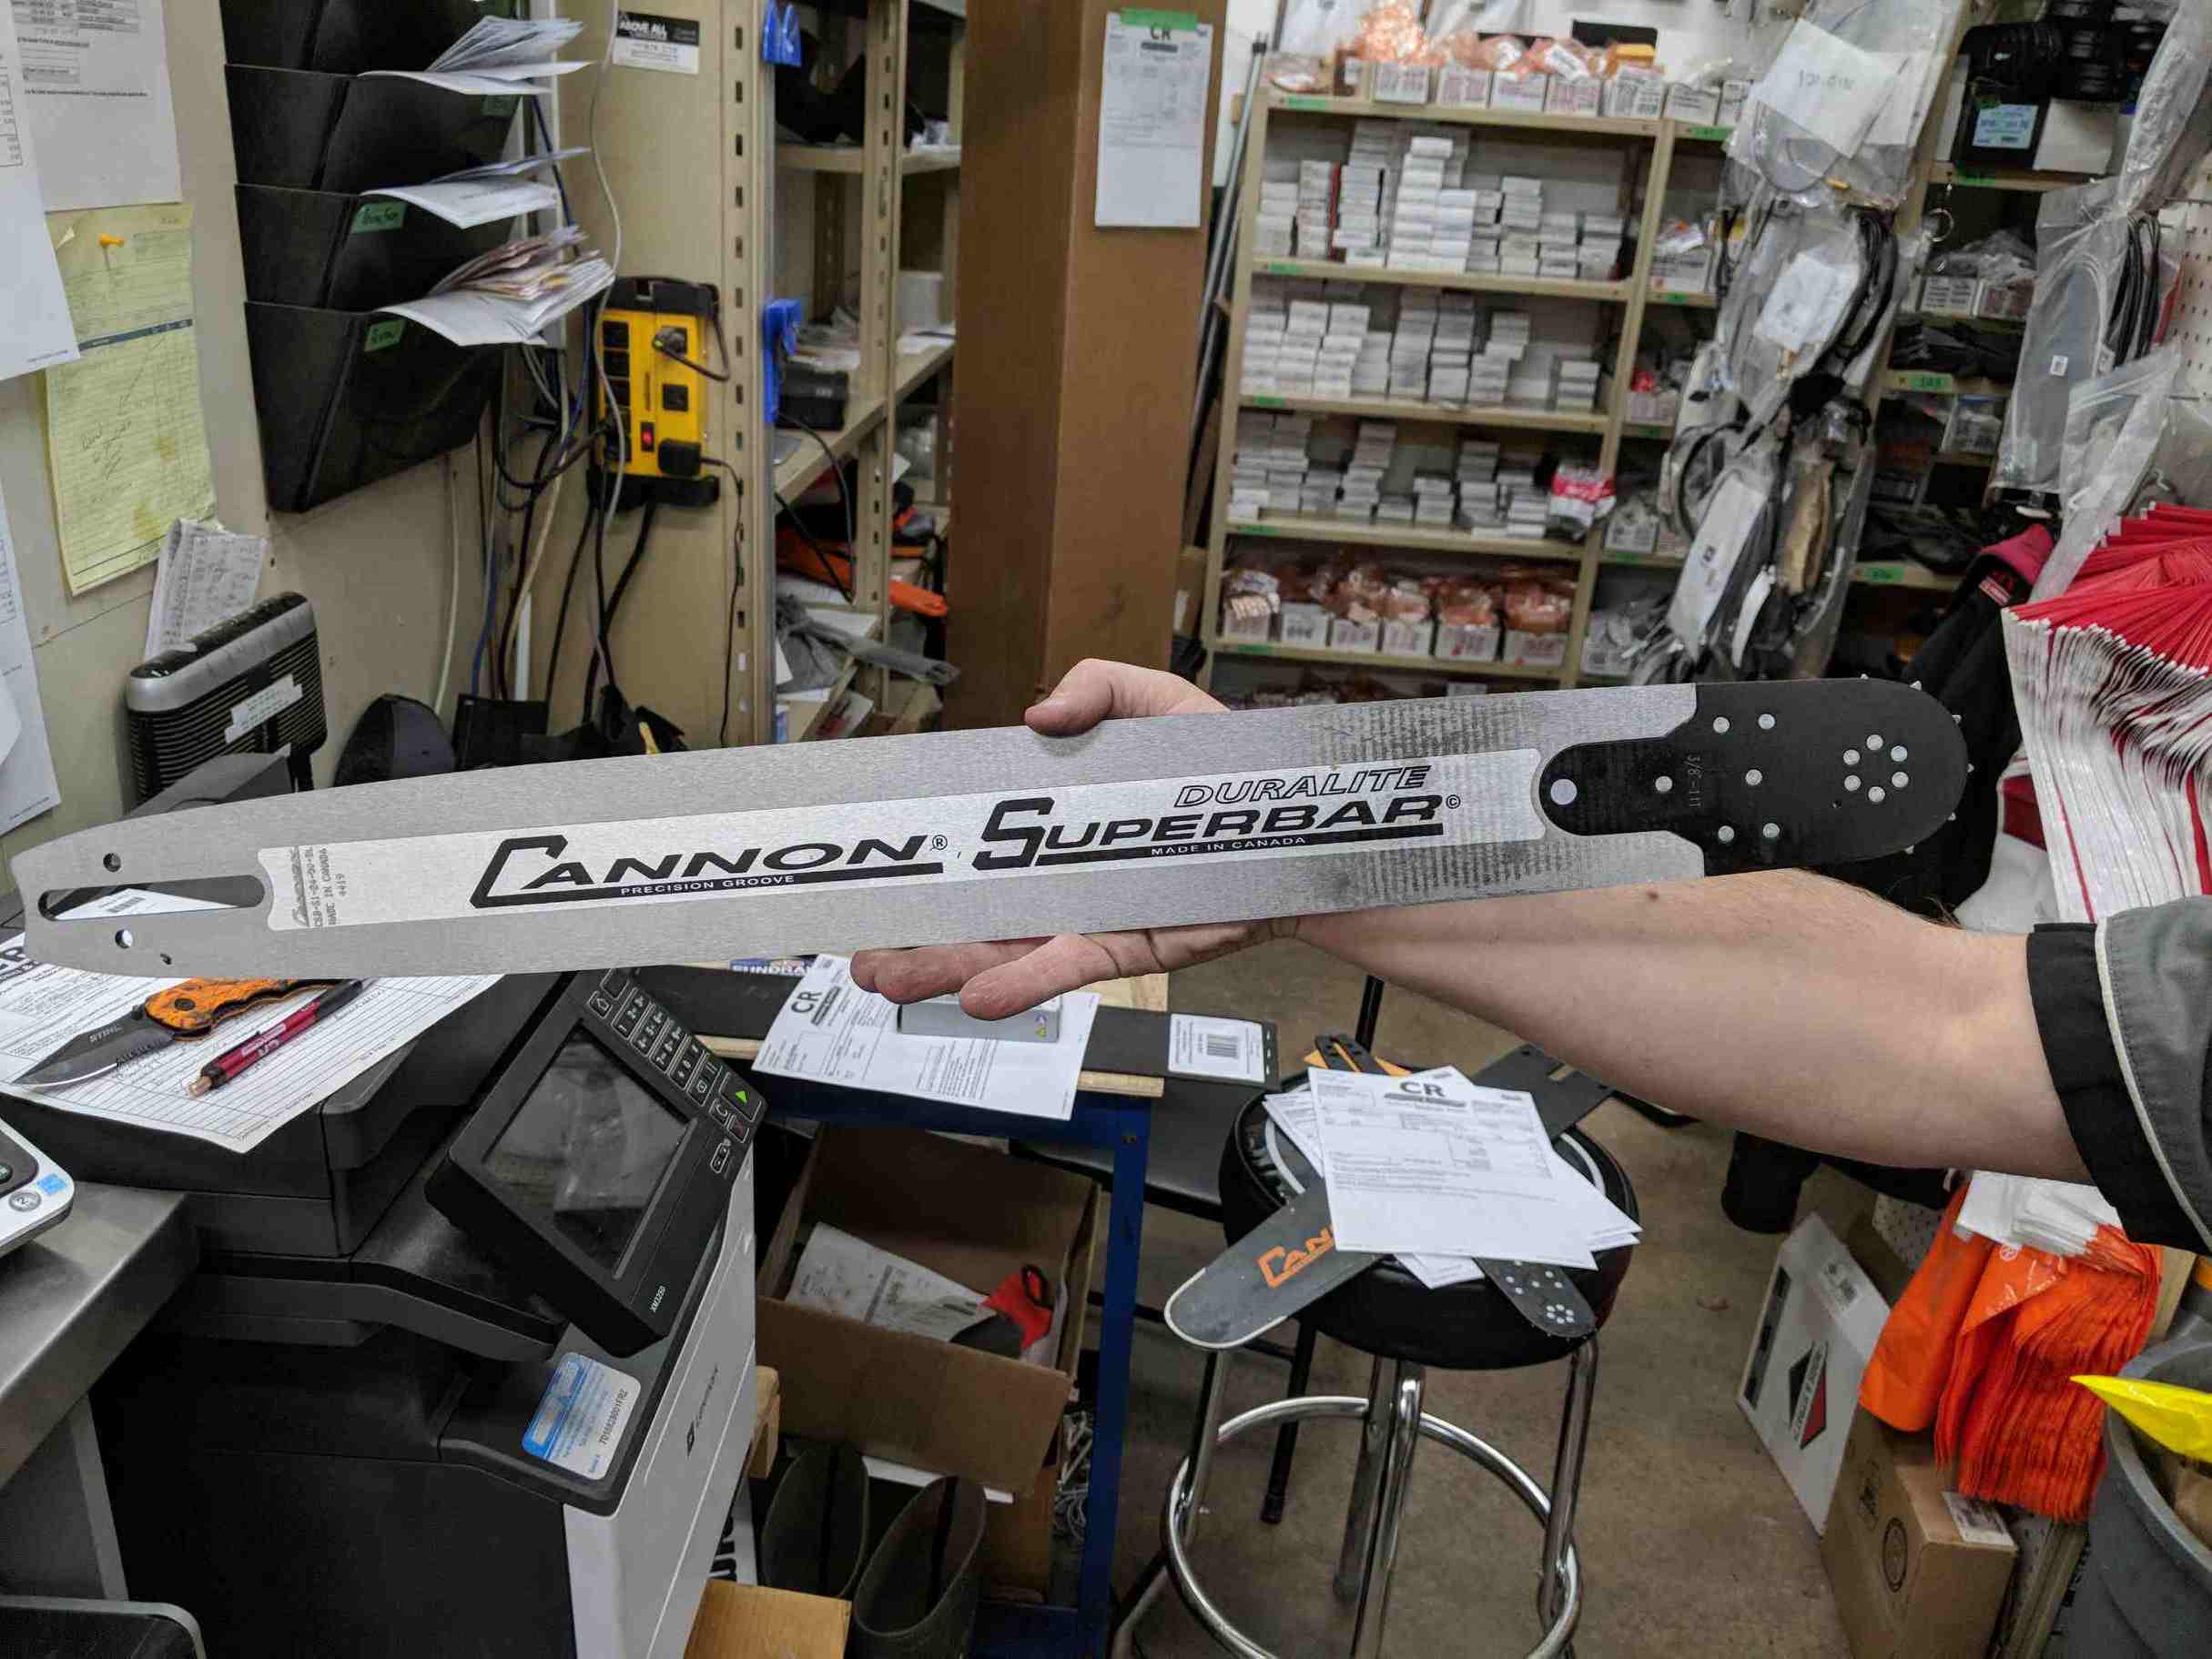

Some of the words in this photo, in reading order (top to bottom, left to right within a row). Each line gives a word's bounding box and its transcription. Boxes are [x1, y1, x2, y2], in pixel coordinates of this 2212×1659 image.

[1173, 764, 1432, 808] DURALITE
[972, 796, 1444, 871] SUPERBAR
[1151, 845, 1201, 856] MADE
[1207, 842, 1225, 853] IN
[1232, 836, 1306, 851] CANADA
[470, 835, 944, 908] CANNON
[620, 880, 715, 895] PRECISION
[722, 875, 795, 889] GROOVE
[791, 990, 823, 1014] CR
[1400, 1080, 1446, 1098] CR
[1257, 1228, 1334, 1289] CAN
